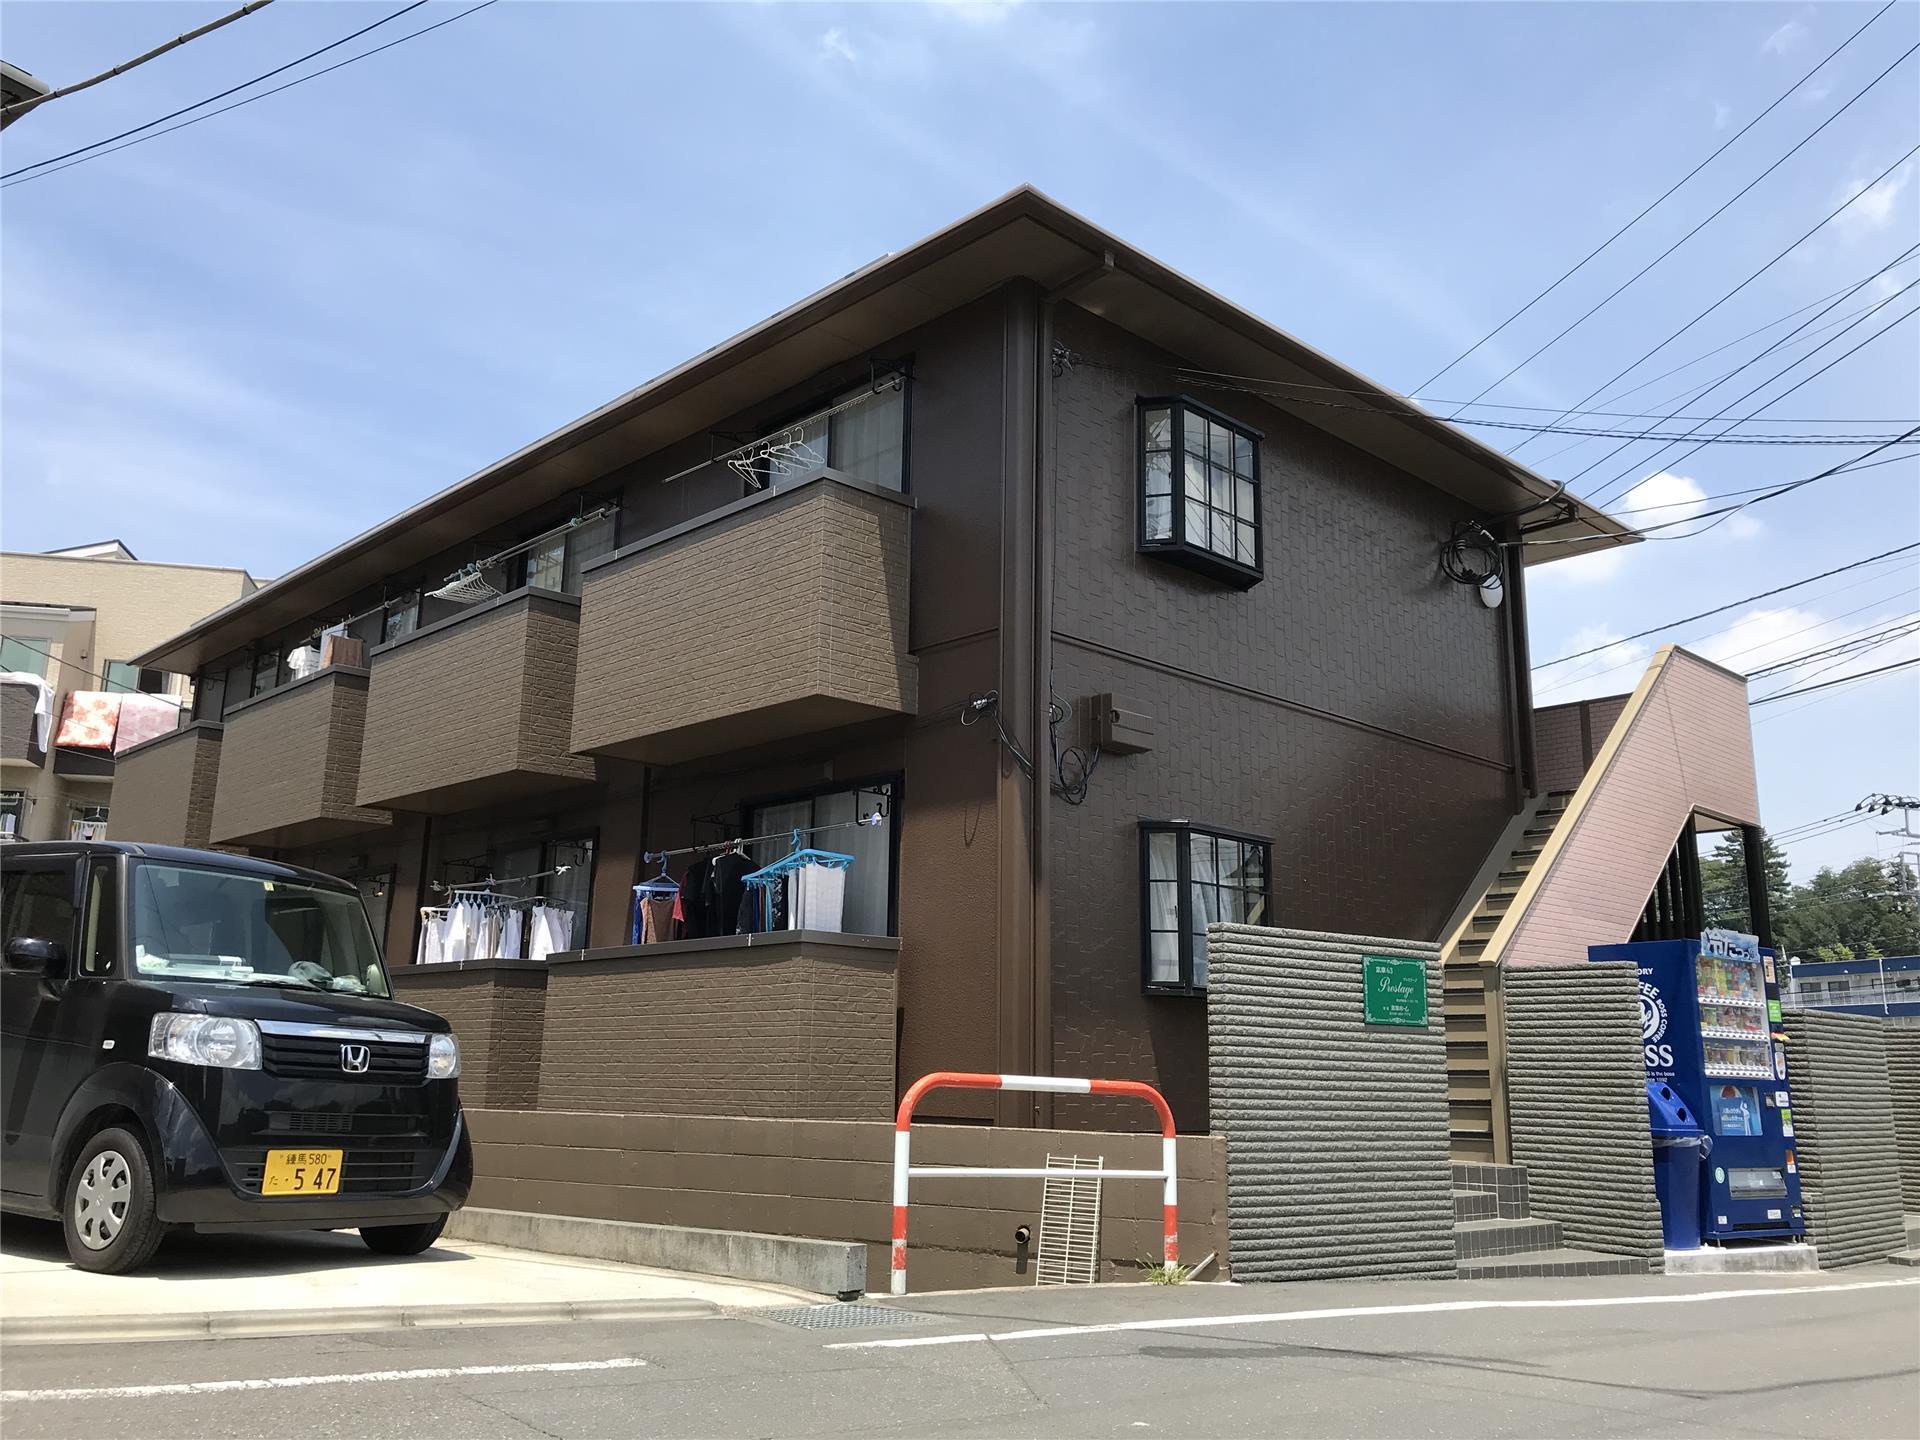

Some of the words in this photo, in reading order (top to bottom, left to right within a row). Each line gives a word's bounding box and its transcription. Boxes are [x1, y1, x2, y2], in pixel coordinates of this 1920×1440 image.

[1637, 967, 1654, 975] ORY
[1638, 981, 1660, 999] FEE
[1656, 998, 1668, 1018] BOSS
[1651, 1019, 1668, 1043] COFFEE
[1645, 1044, 1674, 1067] SS
[269, 1175, 279, 1186] た
